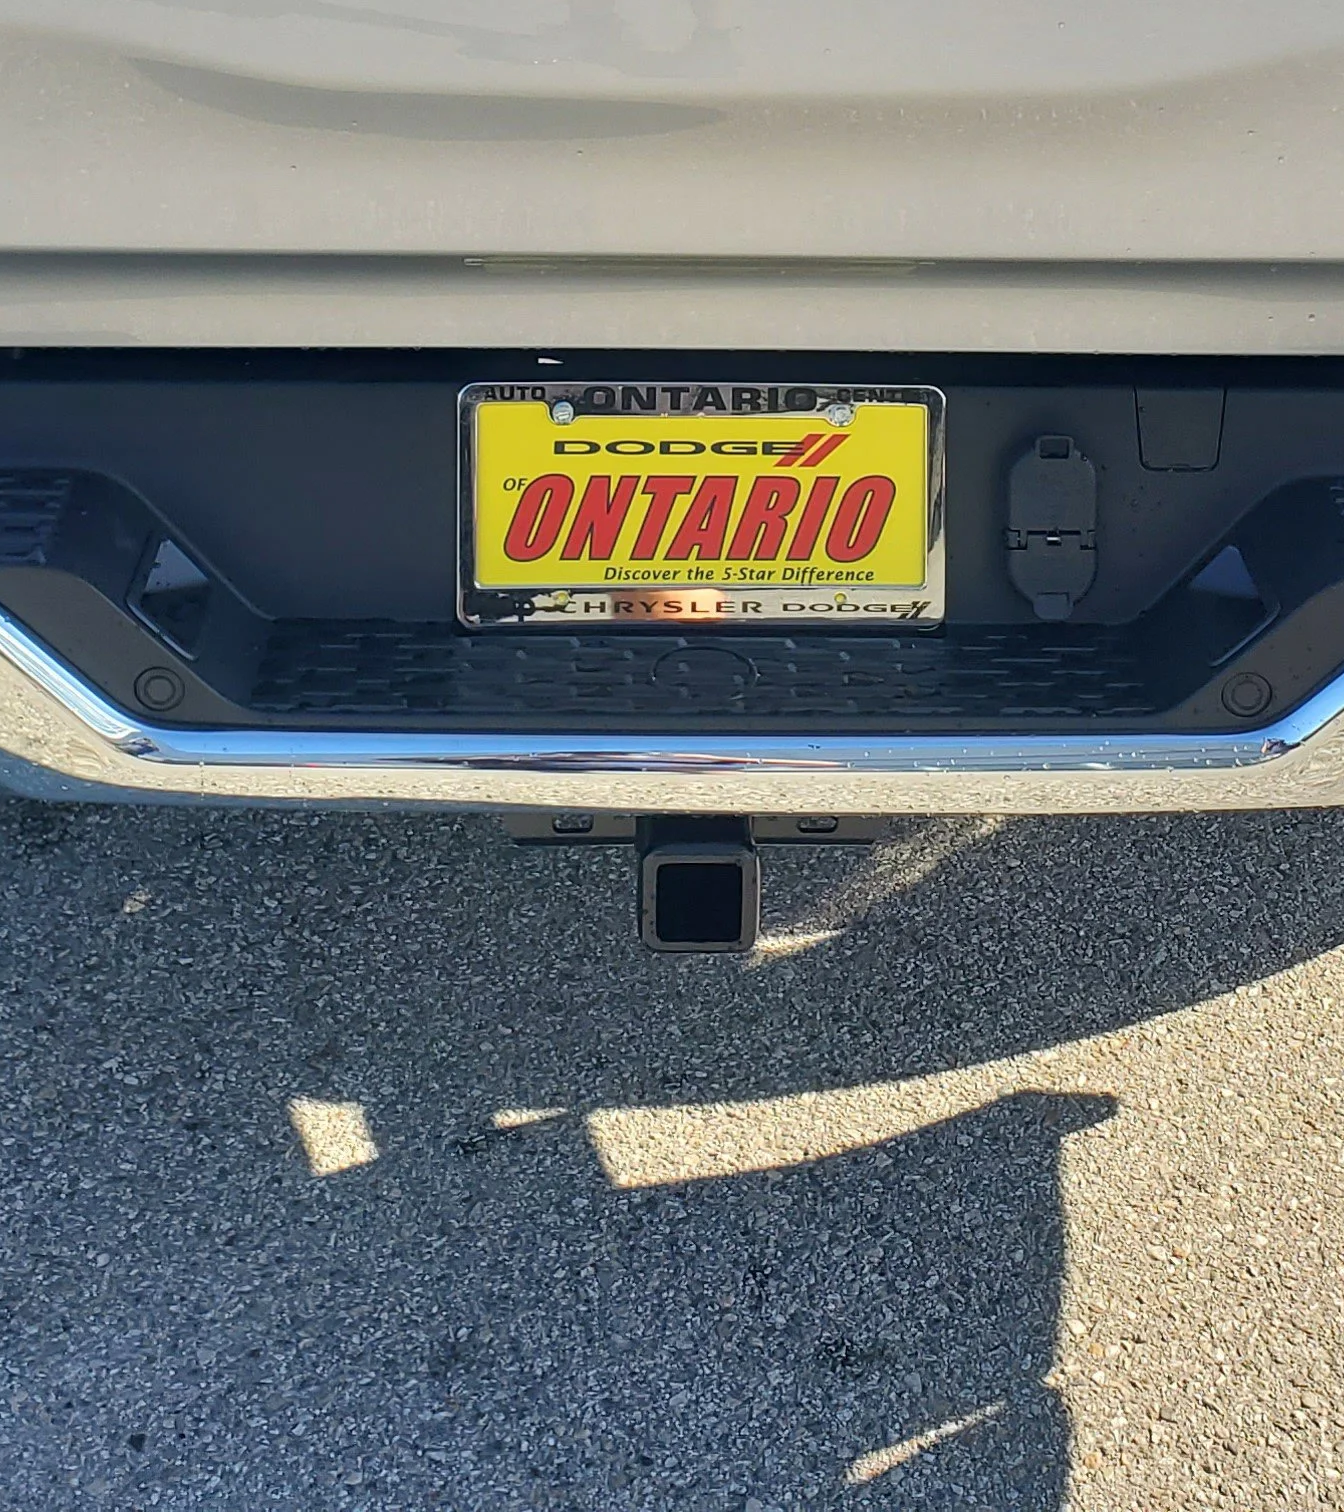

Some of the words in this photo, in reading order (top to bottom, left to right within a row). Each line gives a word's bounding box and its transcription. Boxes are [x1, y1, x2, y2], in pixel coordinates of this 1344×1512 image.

[483, 386, 546, 400] AUTO
[584, 386, 818, 412] ONTARIO
[554, 440, 806, 456] DODGE
[503, 477, 528, 492] OF
[503, 473, 897, 563] ONTARIO
[604, 566, 681, 581] Discover
[687, 567, 715, 581] the
[721, 567, 776, 581] 5-Star
[781, 567, 875, 586] Difference
[563, 600, 763, 614] CHRYSLER
[782, 603, 912, 613] DODGE
